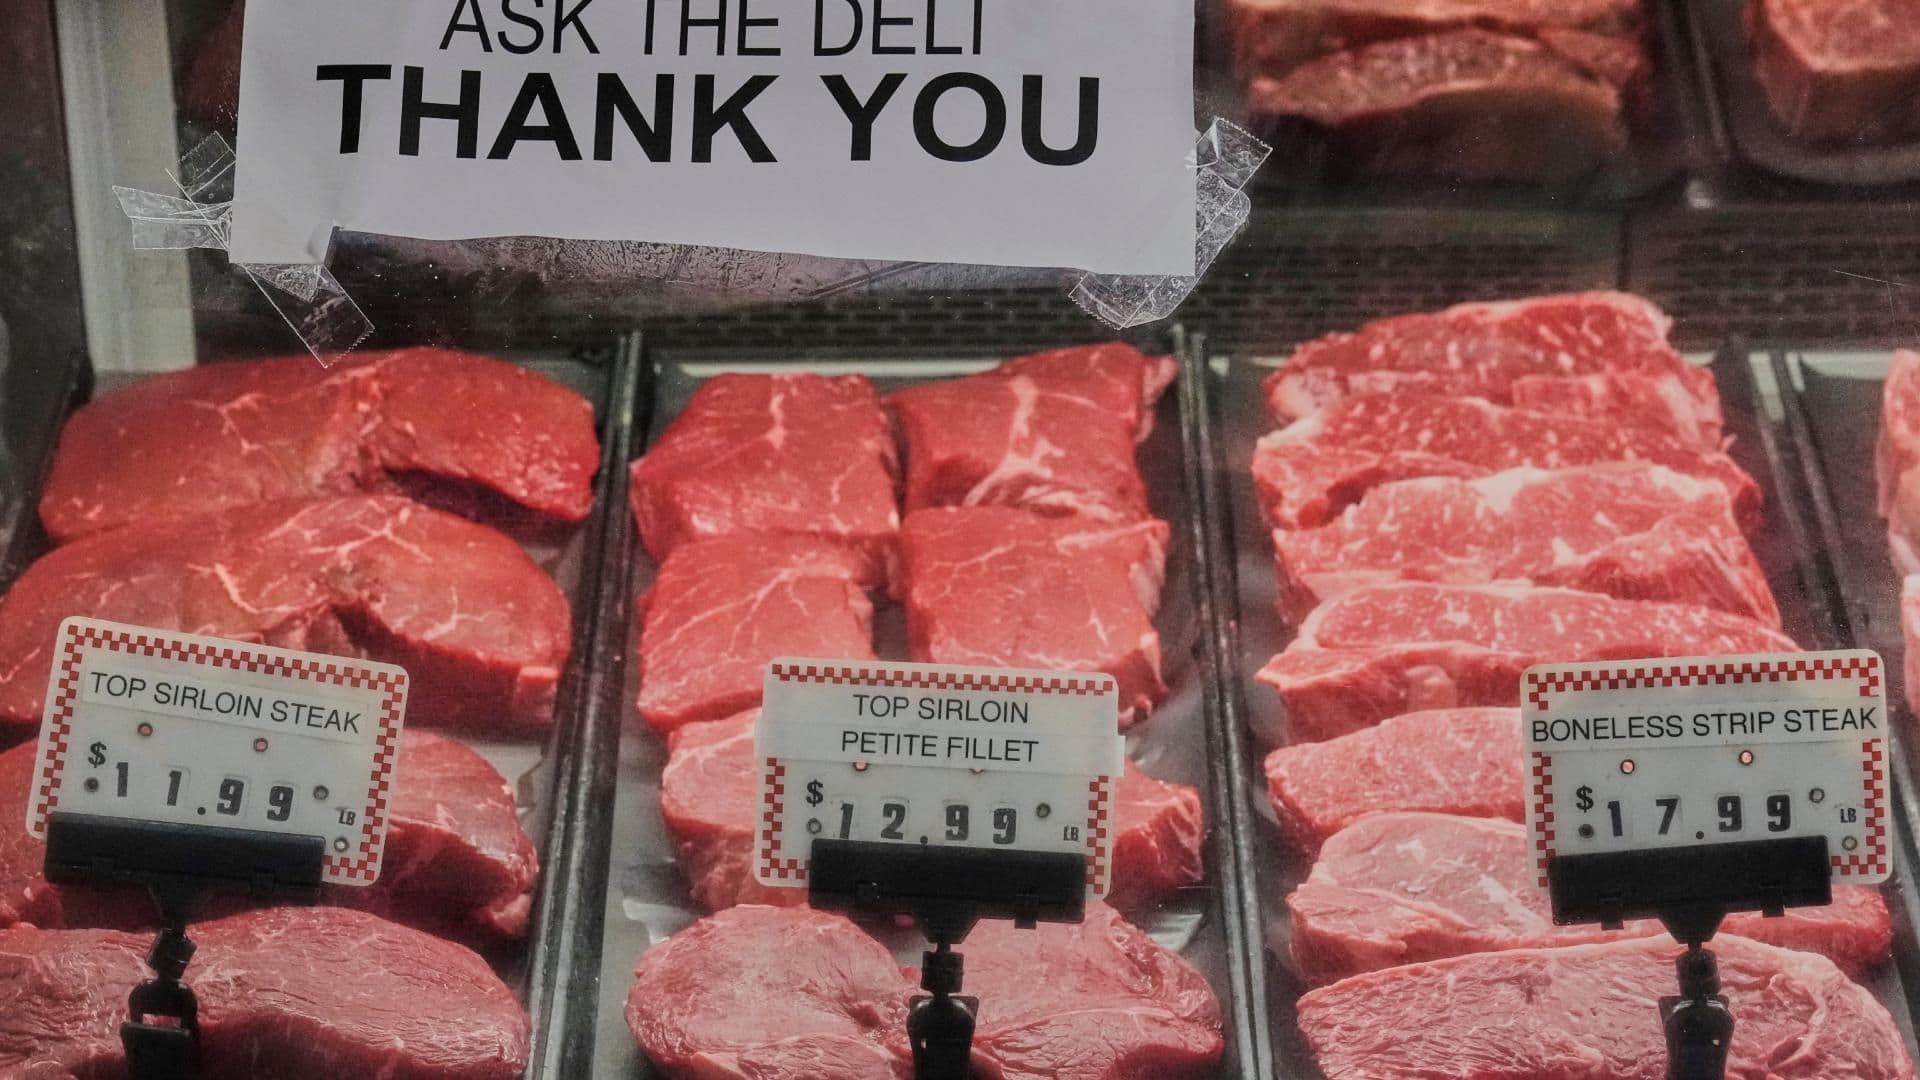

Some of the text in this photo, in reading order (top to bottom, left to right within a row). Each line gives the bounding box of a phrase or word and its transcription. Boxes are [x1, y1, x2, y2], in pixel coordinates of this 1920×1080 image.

[439, 0, 600, 55] ASK
[814, 0, 983, 57] DELI
[316, 64, 1100, 167] THANK YOU
[91, 672, 361, 733] TOP SIRLOIN STEAK
[853, 694, 1028, 724] TOP SIRLOIN
[1532, 706, 1877, 743] BONELESS STRIP STEAK
[841, 731, 1040, 763] PETITE FILLET
[338, 810, 356, 826] LB
[1840, 807, 1857, 823] LB
[1062, 825, 1079, 842] LB
